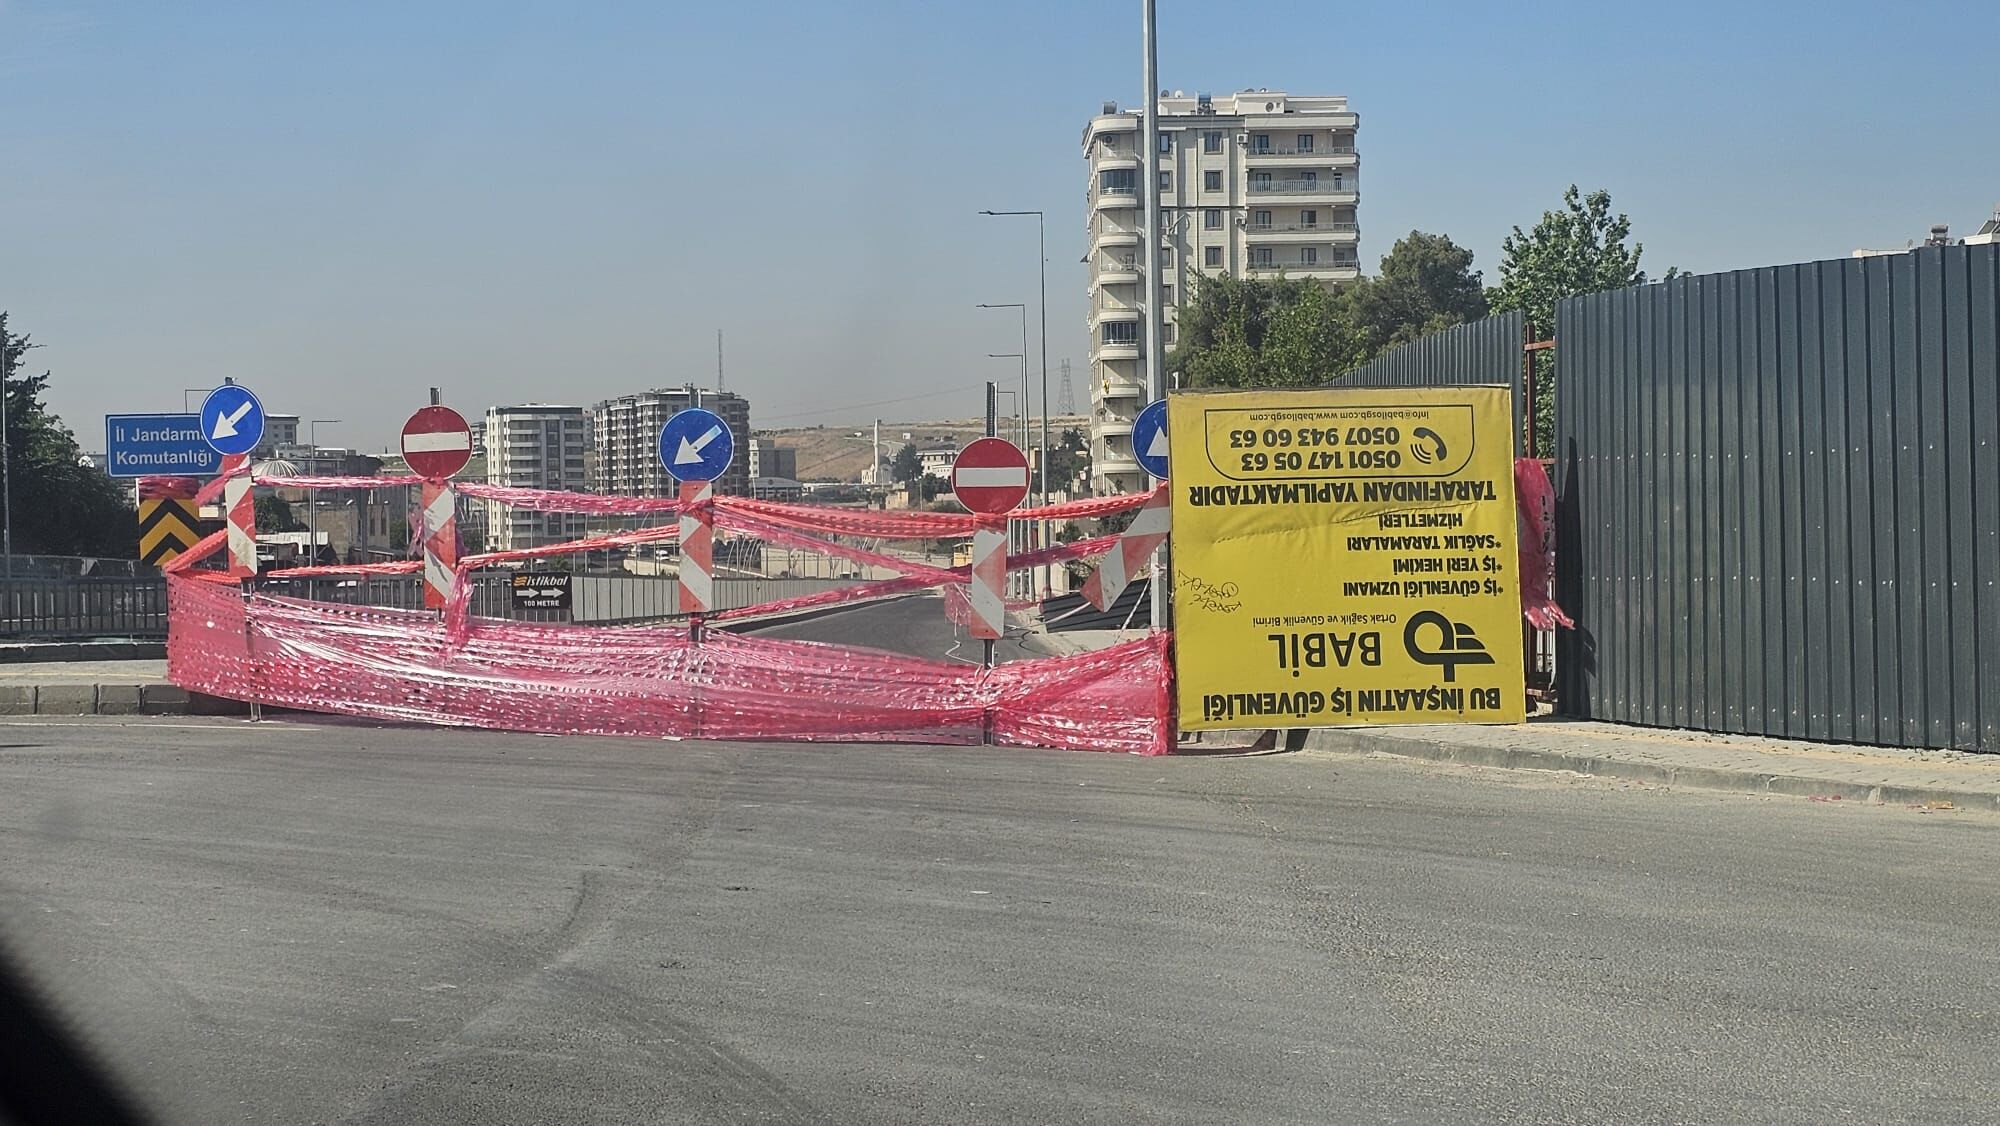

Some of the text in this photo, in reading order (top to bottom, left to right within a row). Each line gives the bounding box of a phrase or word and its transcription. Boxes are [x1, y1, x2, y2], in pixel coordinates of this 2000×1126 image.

[116, 426, 125, 443] İl
[1229, 427, 1400, 449] 0507 943 60 63
[116, 449, 213, 467] Komutanlığı
[1241, 451, 1401, 471] 0501 147 05 63
[1189, 480, 1496, 506] TARAFINDAN YAPILMAKTADIR
[1379, 513, 1463, 530] HİZMETLERİ
[1347, 536, 1439, 550] TARAMALARI
[1393, 559, 1443, 575] HEKİMİ
[1447, 558, 1478, 574] YERİ
[1343, 582, 1400, 596] UZMANI
[1404, 580, 1480, 597] GÜVENLİĞİ
[1252, 613, 1396, 627] Ortak Sağlık ve Güvenlik Birimi
[1268, 632, 1381, 677] BABİL
[1203, 685, 1500, 721] BU İNŞAATIN İŞ GÜVENLİĞİ
